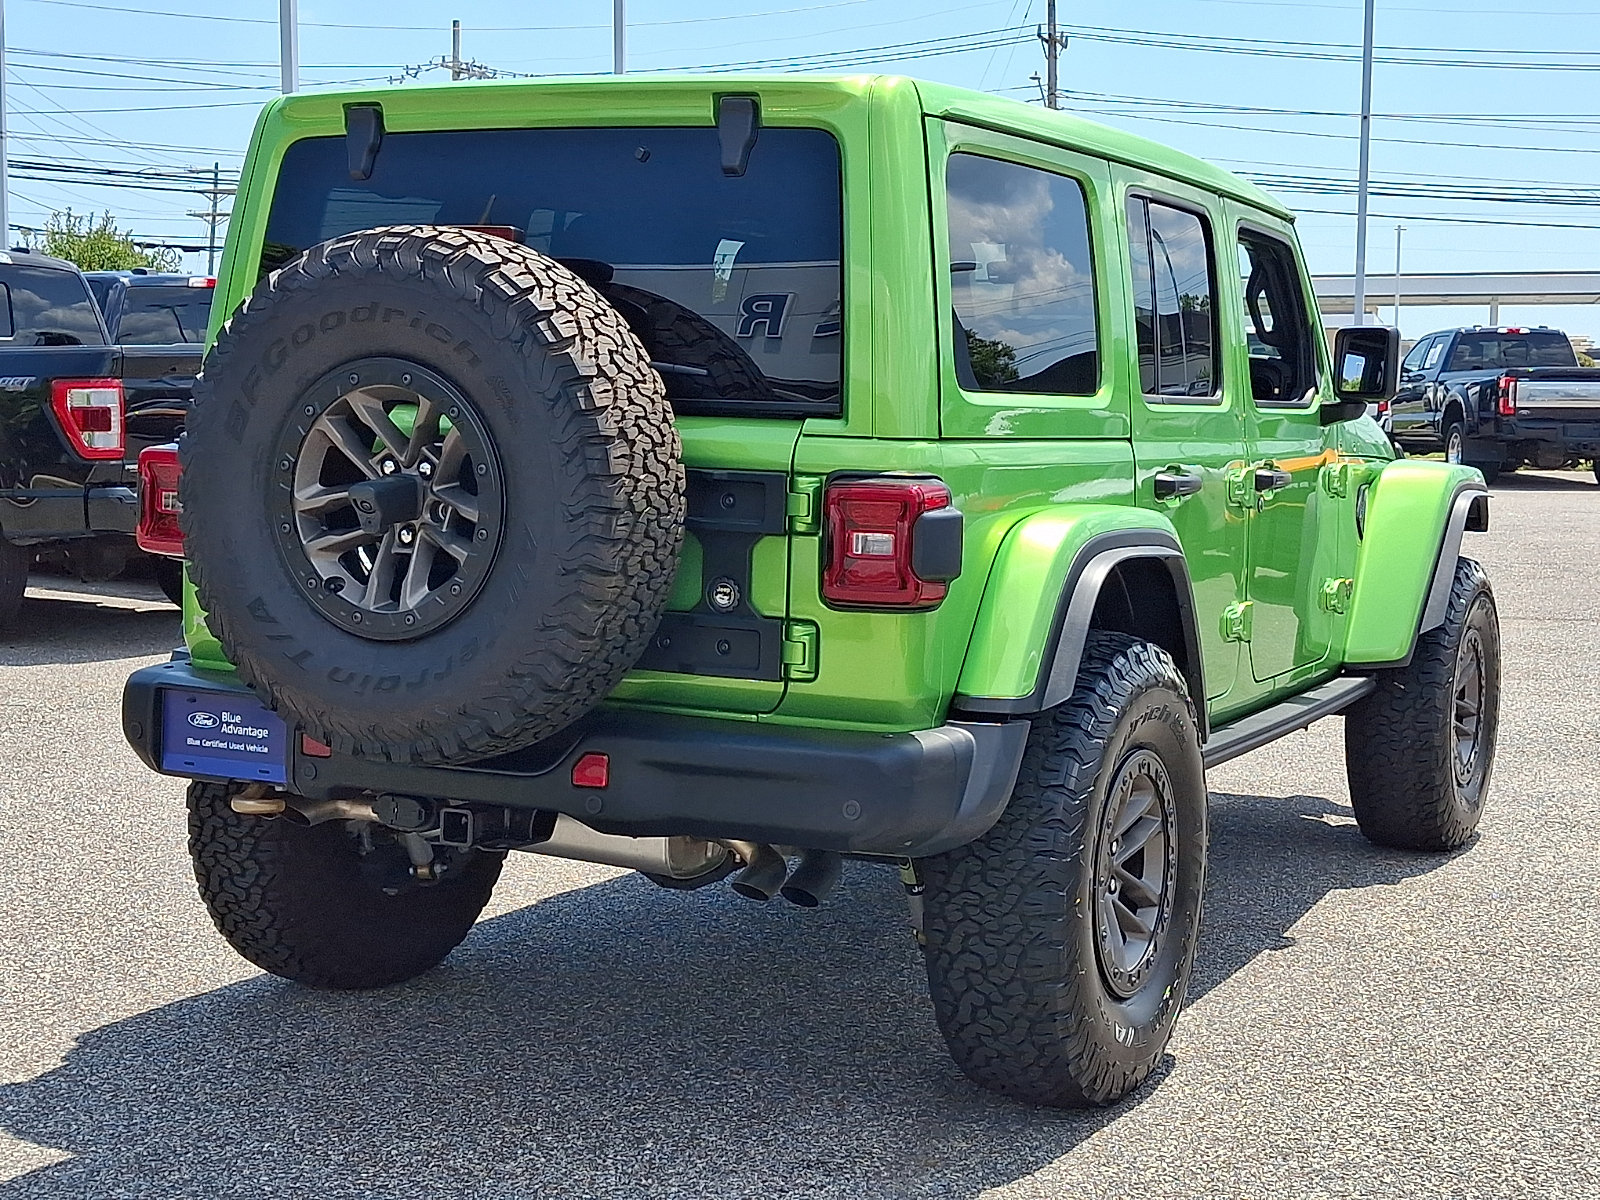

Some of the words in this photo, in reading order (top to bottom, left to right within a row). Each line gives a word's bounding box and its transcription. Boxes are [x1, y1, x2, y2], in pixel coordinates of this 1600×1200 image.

[192, 713, 216, 727] Ford
[221, 711, 242, 723] Blue
[221, 723, 269, 739] Advantage
[187, 737, 201, 746] Blue
[201, 739, 228, 749] Certified
[229, 742, 245, 751] Used
[246, 743, 269, 753] Vehicle
